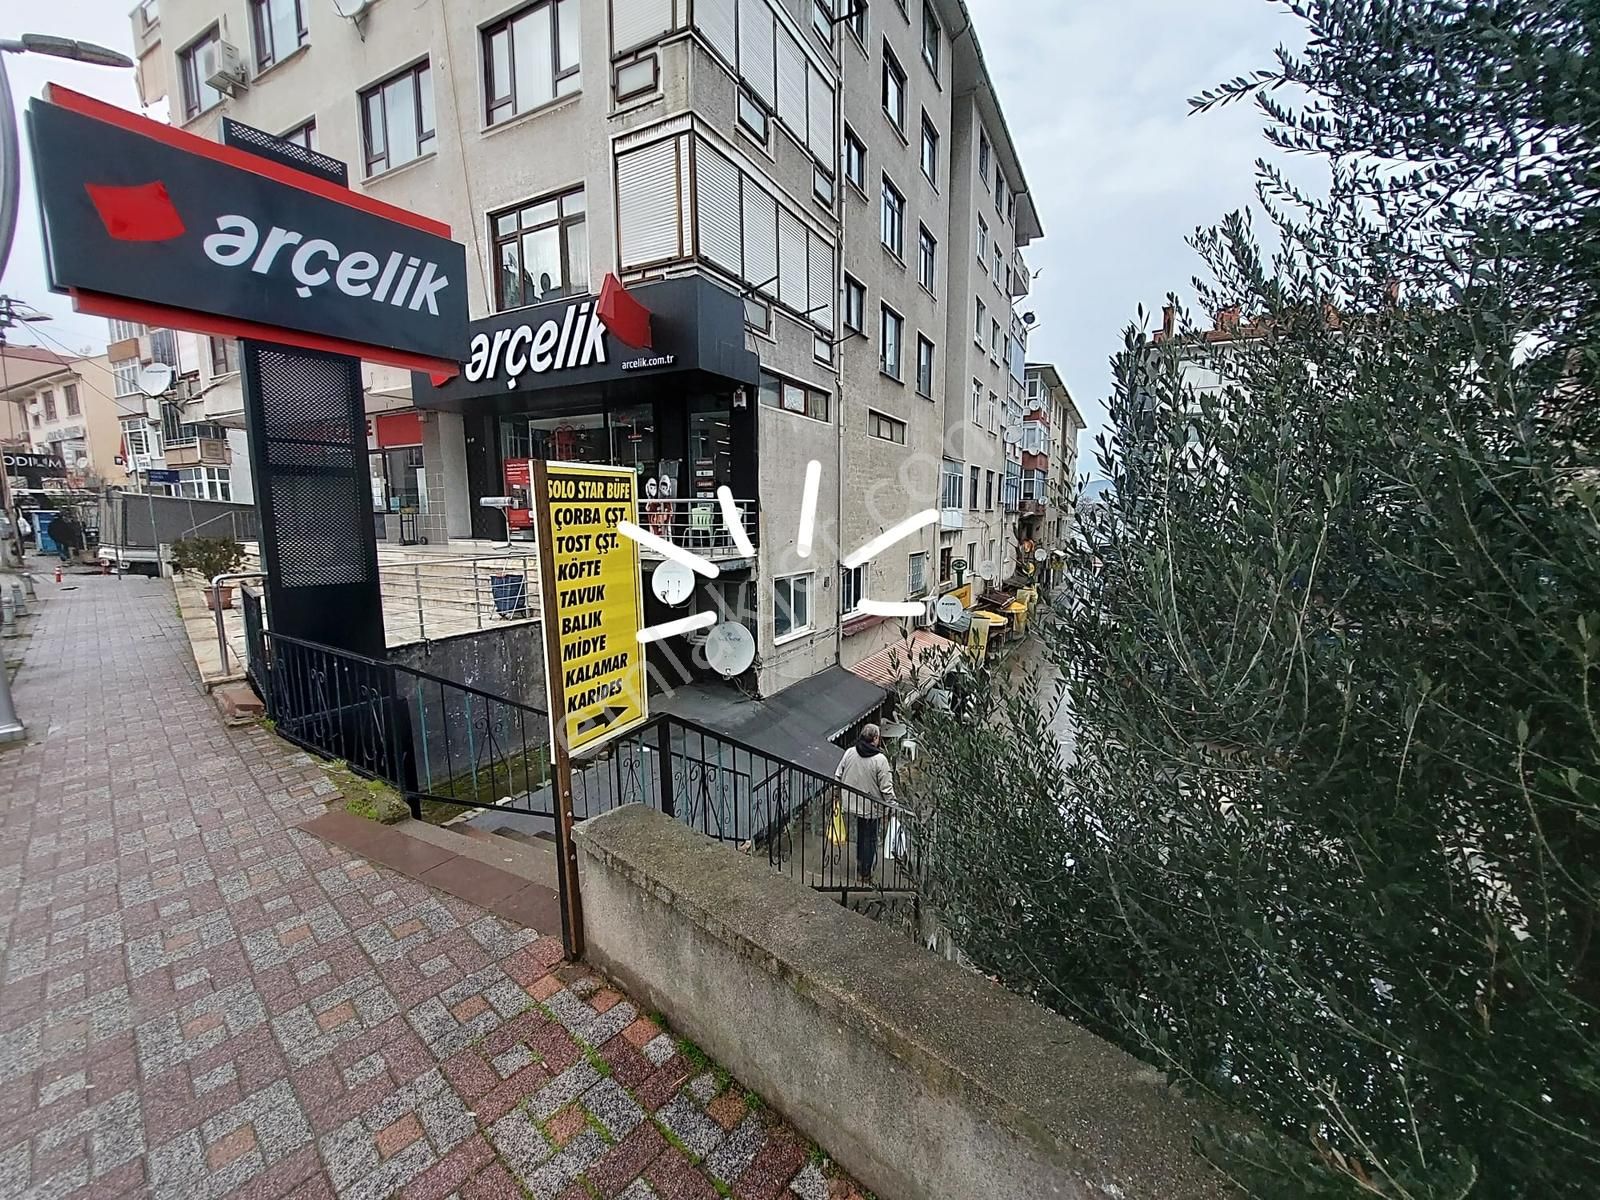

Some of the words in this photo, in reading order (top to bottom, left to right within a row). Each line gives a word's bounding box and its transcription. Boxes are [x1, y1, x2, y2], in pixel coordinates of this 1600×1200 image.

[203, 214, 448, 317] arçelik
[465, 300, 607, 389] arçelik
[621, 354, 674, 370] arcelik.com.tr
[547, 480, 576, 499] SOLO
[578, 481, 604, 499] STAR
[606, 478, 630, 499] BÜFE
[554, 507, 602, 531] ÇORBA
[556, 535, 592, 554] TOST
[557, 557, 602, 582] KÖFTE
[560, 584, 606, 608] TAVUK
[561, 610, 602, 636] BALIK
[563, 634, 606, 662] MİDYE
[565, 652, 628, 688] KALAMAR
[567, 677, 623, 714] KARİDES
